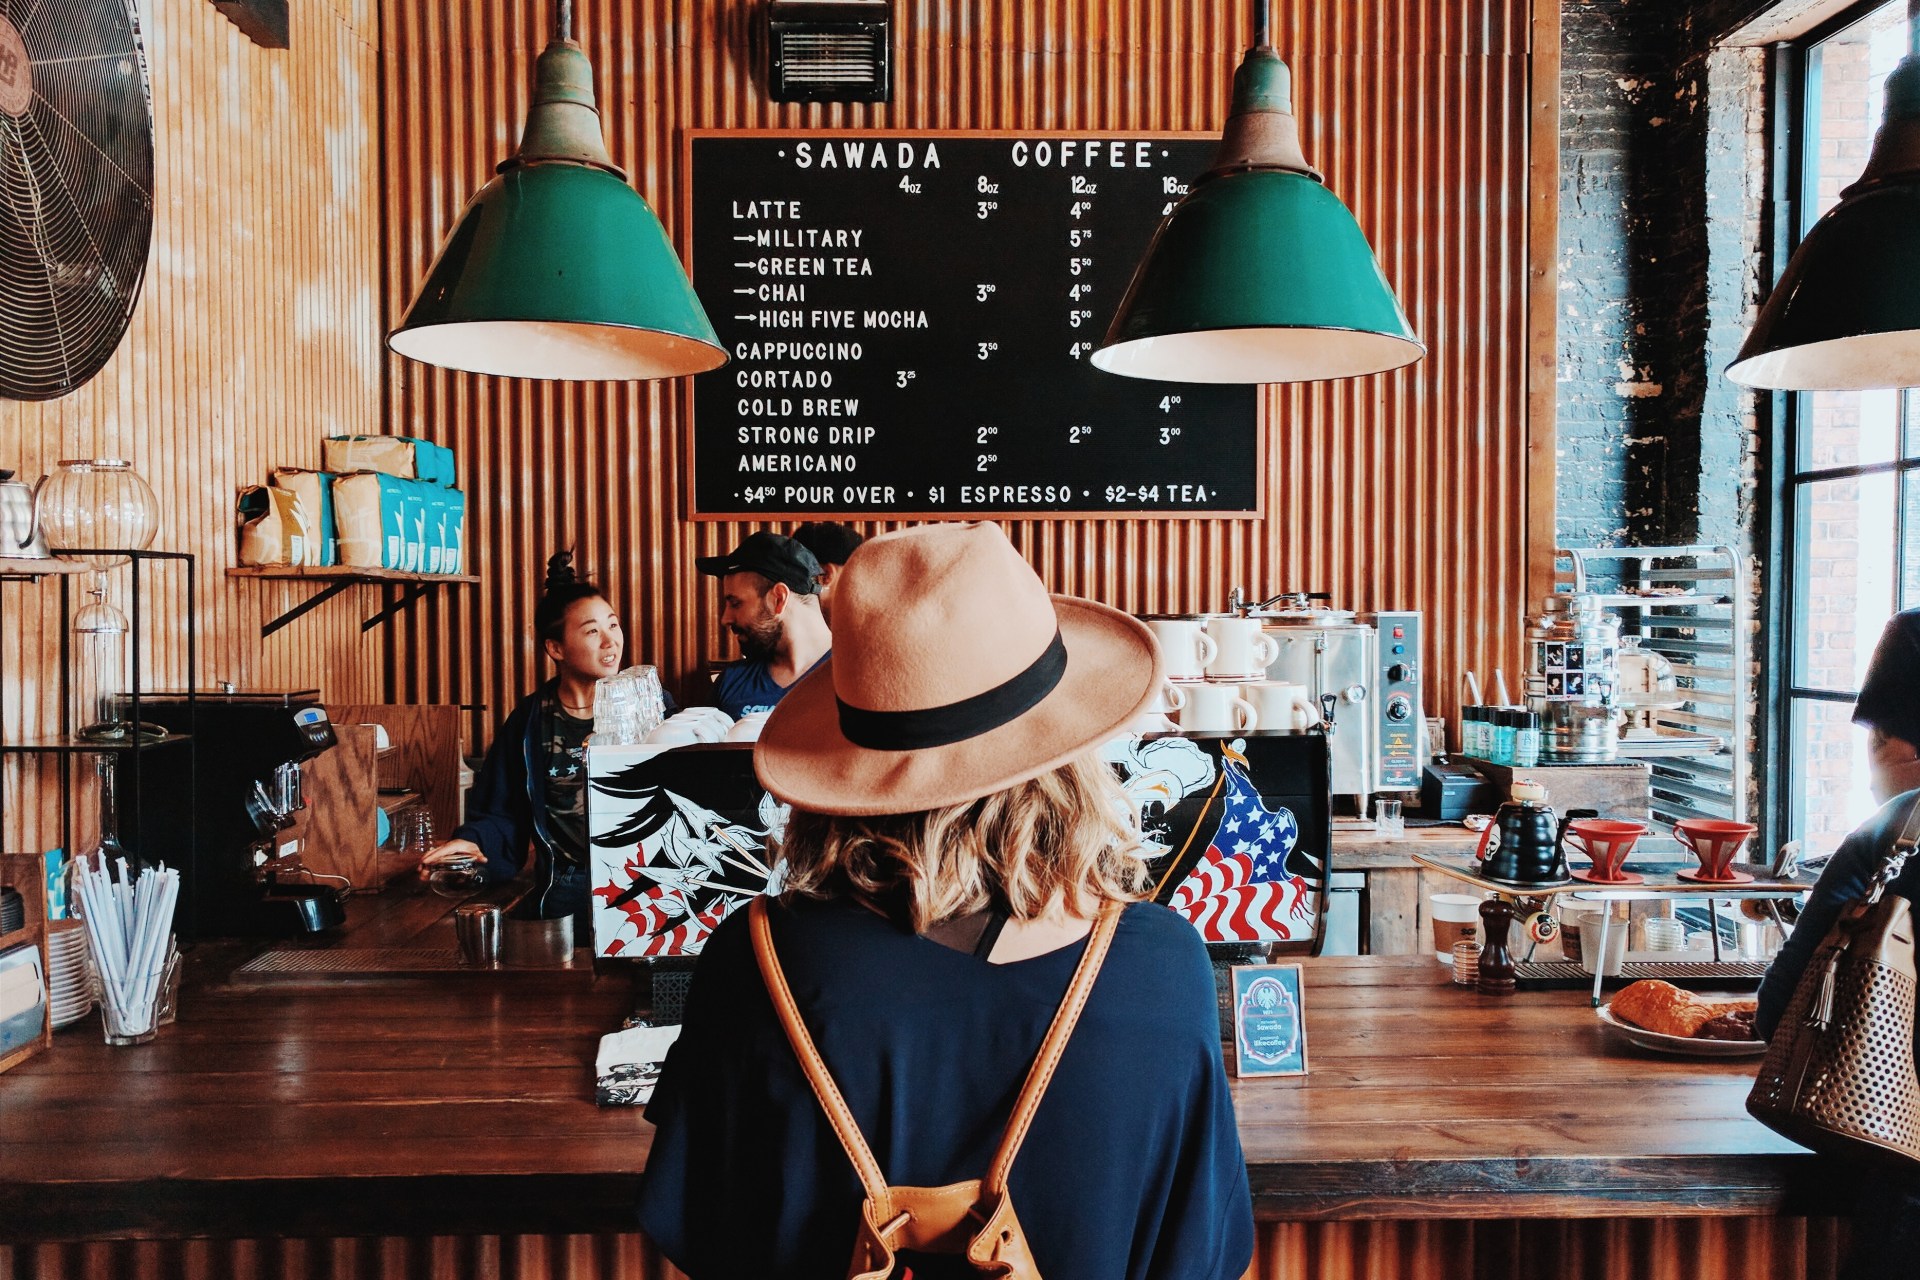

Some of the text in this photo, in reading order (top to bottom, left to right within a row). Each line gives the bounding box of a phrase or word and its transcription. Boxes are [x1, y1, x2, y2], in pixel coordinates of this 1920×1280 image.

[795, 140, 1152, 169] SAWADA COFFEE
[732, 200, 801, 219] LATTE
[757, 229, 863, 248] MILITARY
[757, 257, 825, 276] GREEN
[832, 257, 873, 276] TEA
[758, 283, 805, 302] CHAI
[759, 309, 803, 328] HIGH
[811, 310, 856, 329] FIVE
[863, 310, 929, 329] MOCHA
[735, 342, 863, 361] CAPPUCCINO
[736, 370, 833, 389] CORTADO
[737, 398, 793, 417] COLD
[802, 398, 859, 417] BREW
[737, 426, 819, 444] STRONG
[829, 426, 876, 445] DRIP
[738, 454, 856, 473] AMERICANO
[784, 486, 834, 504] POUR
[843, 486, 896, 504] OVER
[928, 486, 945, 504] $1
[961, 485, 1071, 504] ESPRESSO
[1166, 484, 1207, 503] TEA
